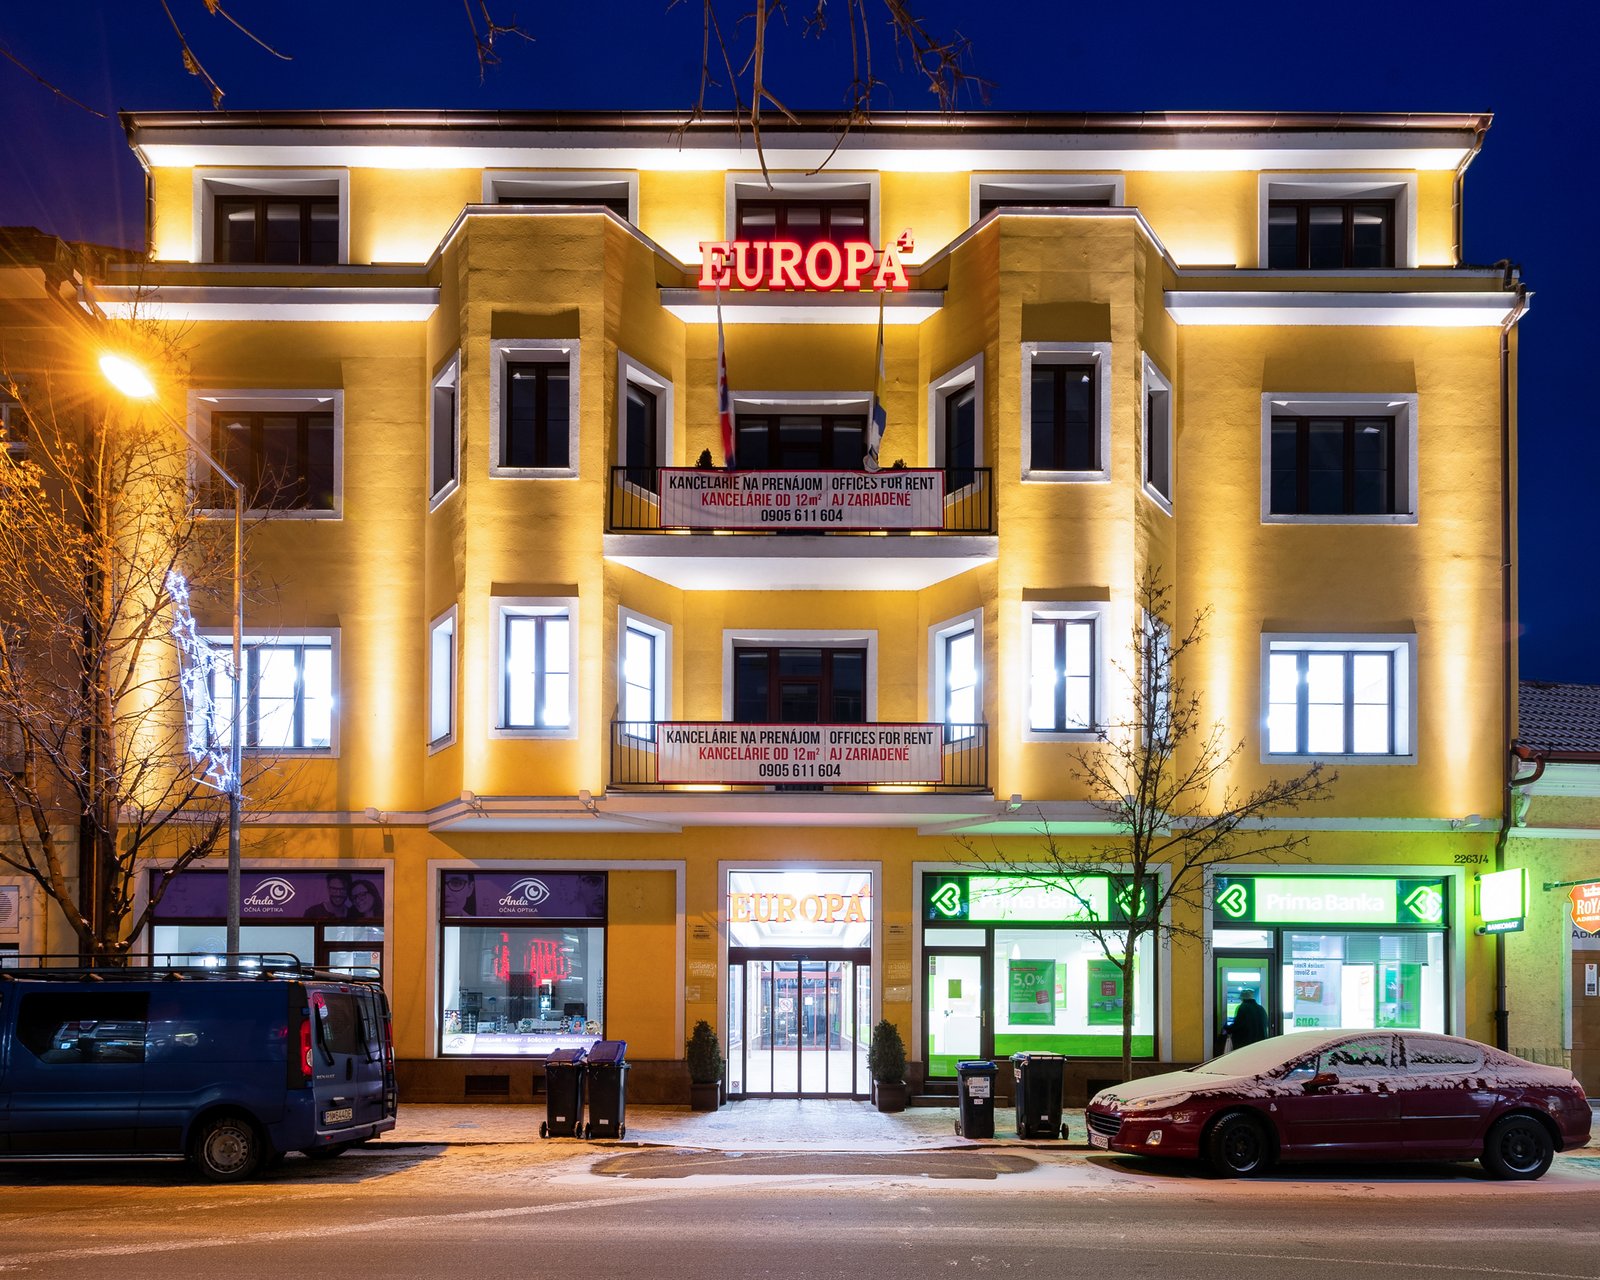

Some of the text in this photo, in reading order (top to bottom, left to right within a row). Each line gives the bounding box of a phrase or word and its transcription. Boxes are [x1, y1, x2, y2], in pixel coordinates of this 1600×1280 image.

[743, 477, 759, 490] NA
[762, 475, 823, 490] PRENÁJOM
[831, 476, 878, 490] OFFICES
[881, 478, 902, 489] FOR
[905, 476, 935, 490] RENT
[702, 491, 772, 506] KANCELÁRIE
[775, 494, 791, 506] OD
[832, 494, 845, 506] AJ
[848, 491, 911, 506] ZARIADENÉ
[761, 509, 843, 522] 0905 611 604
[667, 729, 933, 744] KANCELÁRIE NA PRENÁJOM OFFICES FOR RENT
[700, 745, 770, 760] KANCELÁRIE
[774, 748, 789, 760] OD
[830, 748, 843, 760] AJ
[846, 745, 910, 760] ZARIADENÉ
[759, 764, 841, 777] 0905 611 604
[1454, 854, 1489, 864] 2263/4
[243, 895, 274, 905] Anda
[498, 895, 529, 906] Anda
[1266, 892, 1385, 912] Prima Banka
[1487, 921, 1519, 931] BANKOMAT
